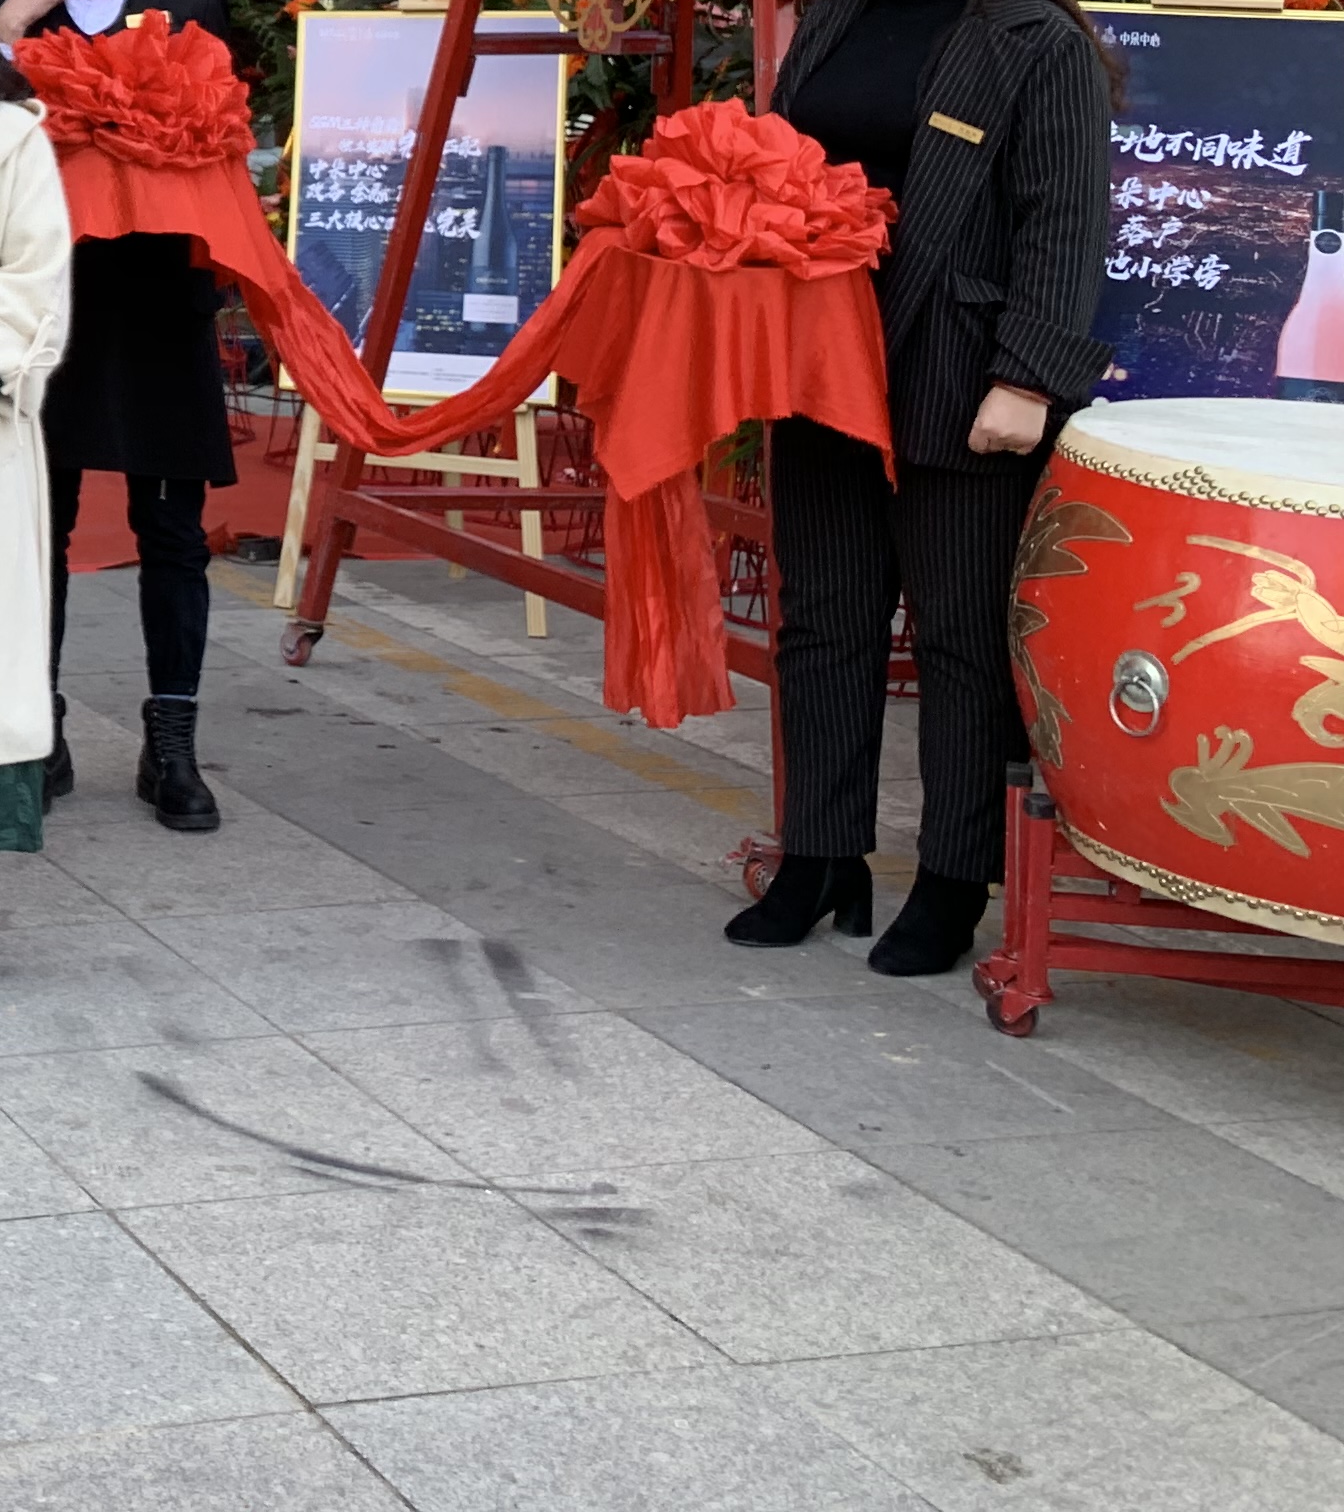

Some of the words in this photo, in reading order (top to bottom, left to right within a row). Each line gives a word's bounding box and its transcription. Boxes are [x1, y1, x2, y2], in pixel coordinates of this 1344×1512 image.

[1111, 121, 1313, 176] 地不同味道
